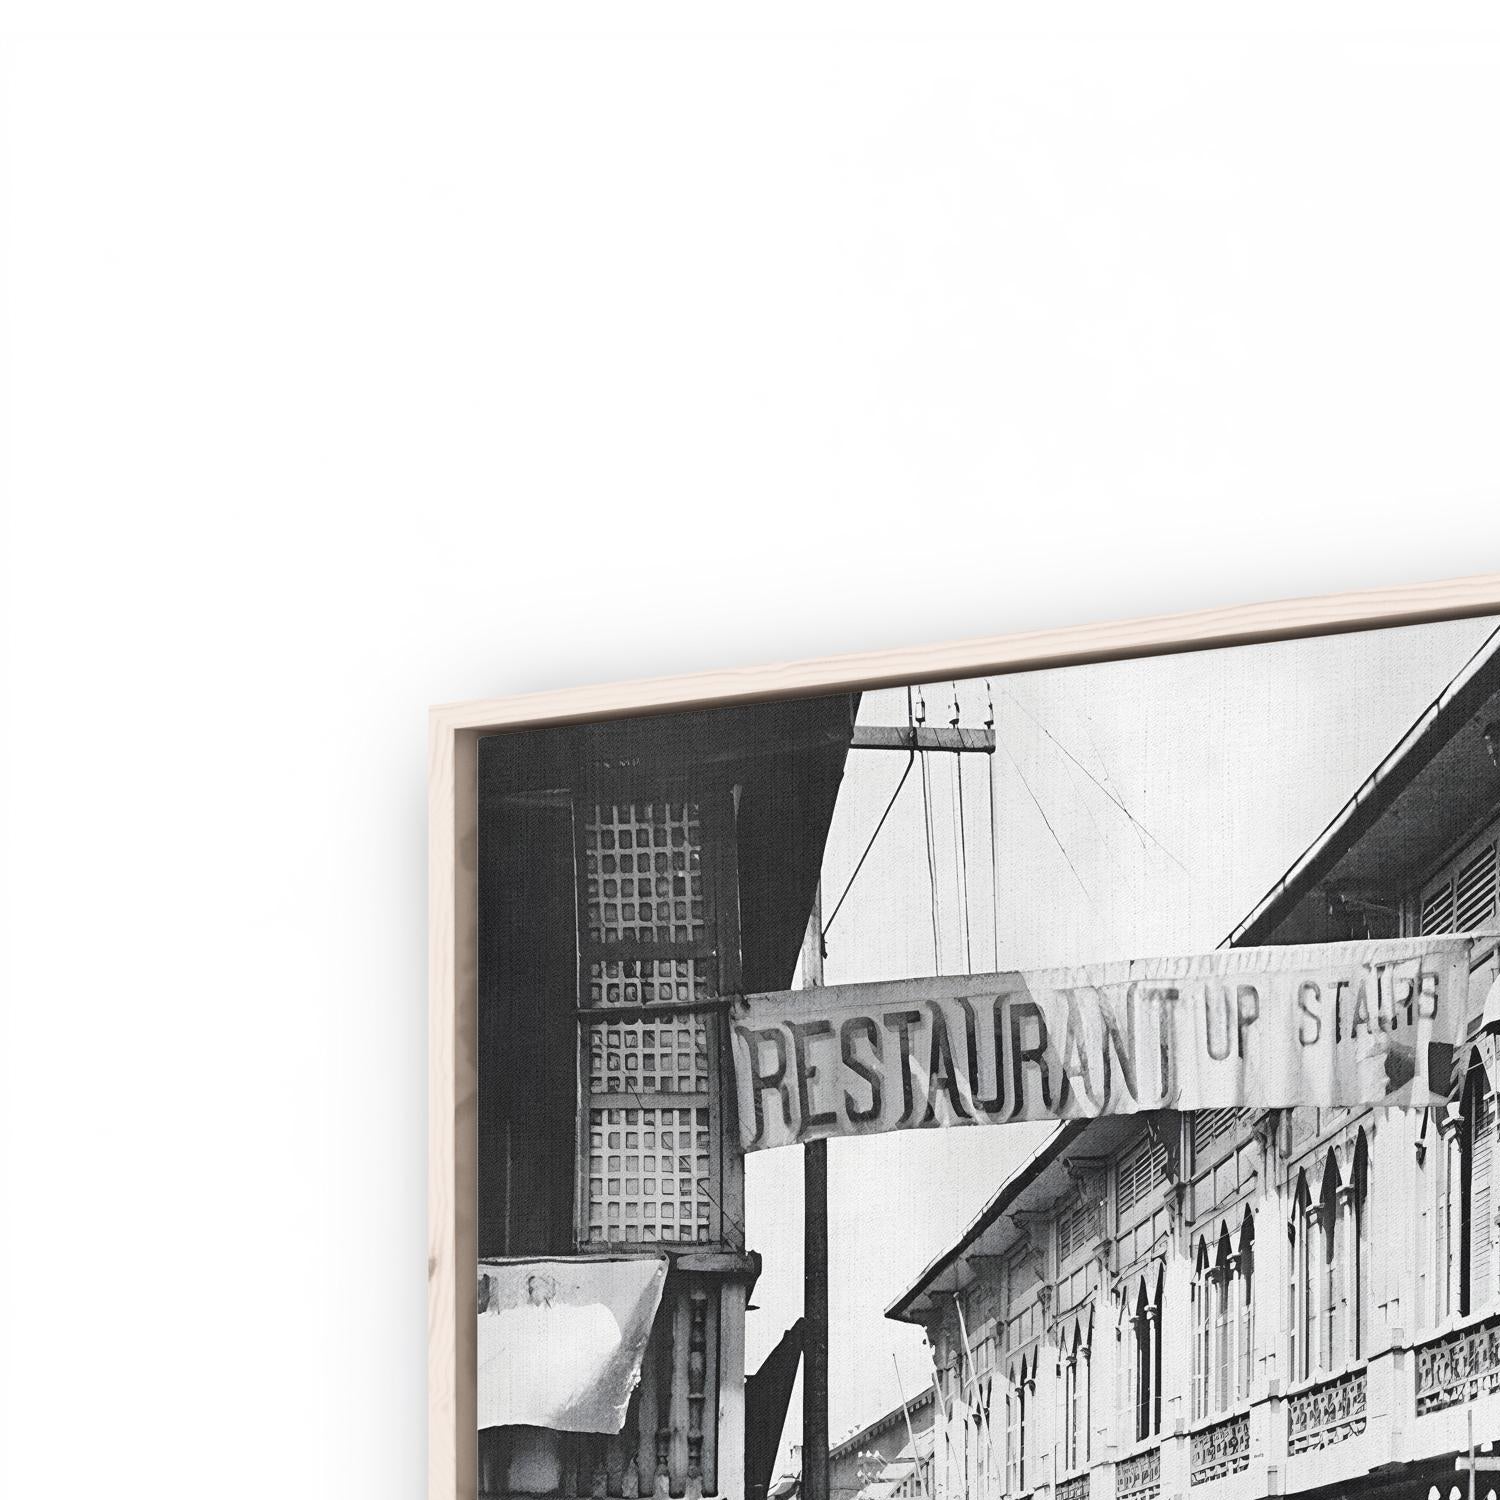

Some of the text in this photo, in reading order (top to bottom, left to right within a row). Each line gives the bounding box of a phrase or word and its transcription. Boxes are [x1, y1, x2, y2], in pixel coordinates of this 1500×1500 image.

[734, 964, 1440, 1146] RESTAURANT UP STAIRS
